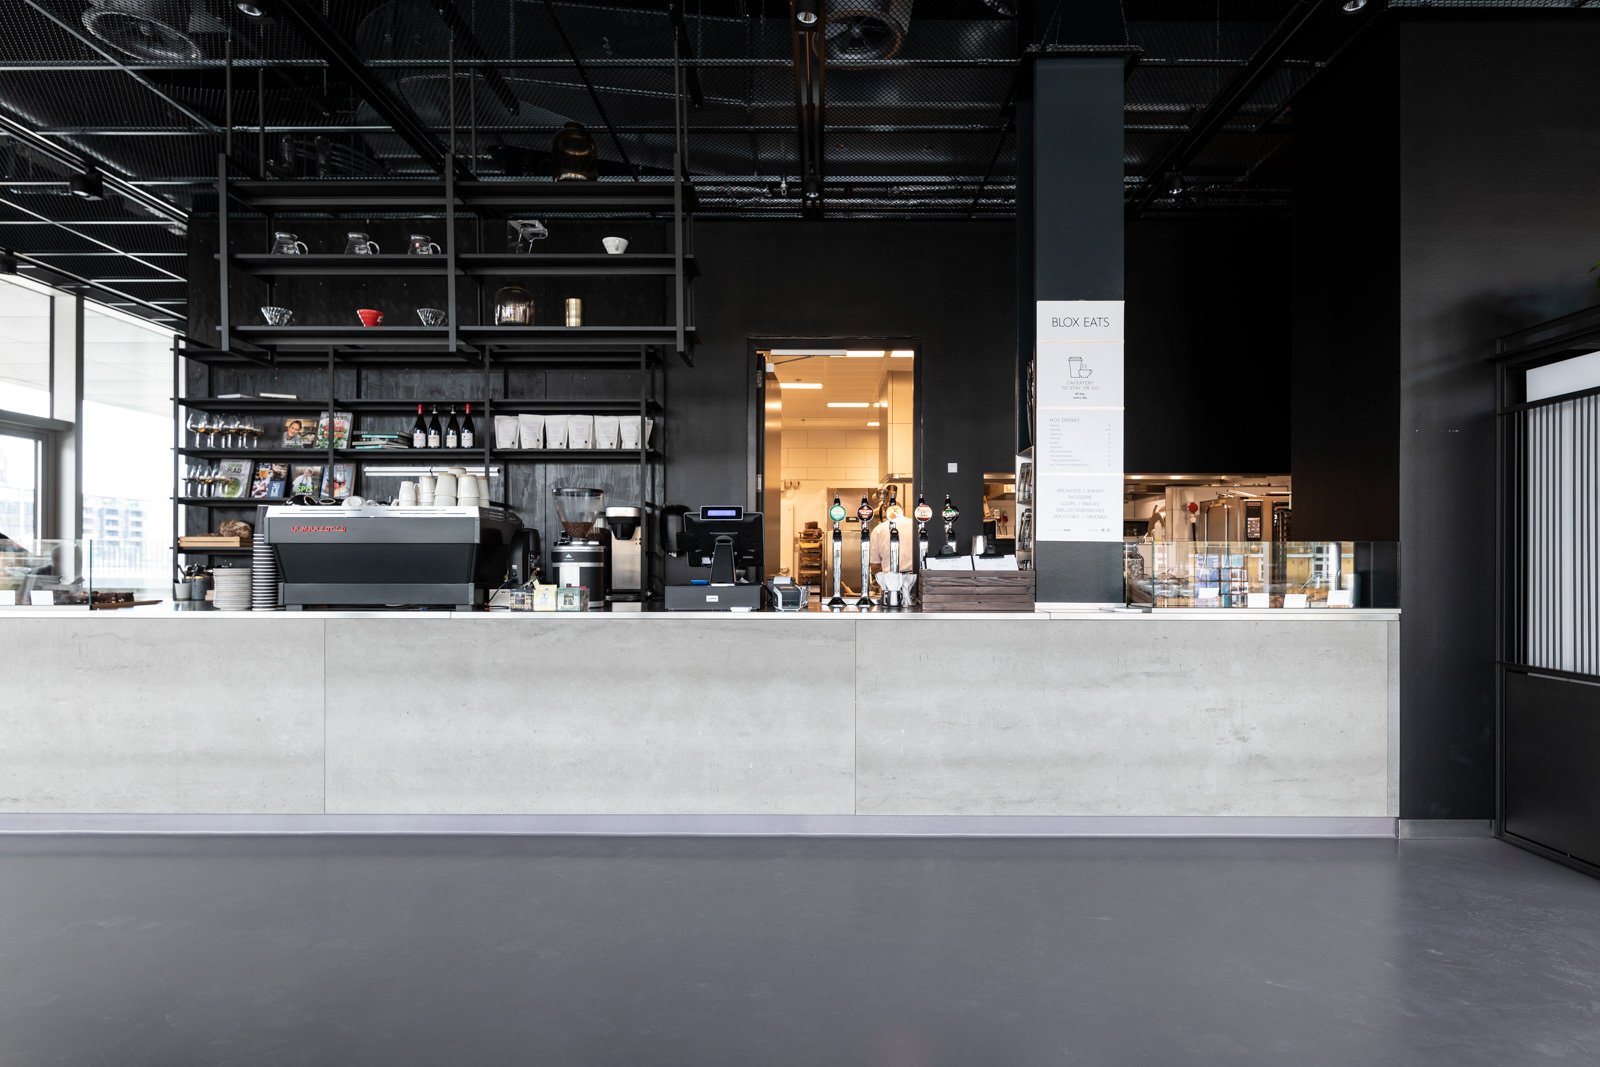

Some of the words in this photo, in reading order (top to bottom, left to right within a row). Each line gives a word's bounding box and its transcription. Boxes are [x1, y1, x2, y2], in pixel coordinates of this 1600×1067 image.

[1052, 317, 1080, 328] BLOX
[1083, 317, 1110, 328] EATS
[296, 485, 313, 493] SPIS
